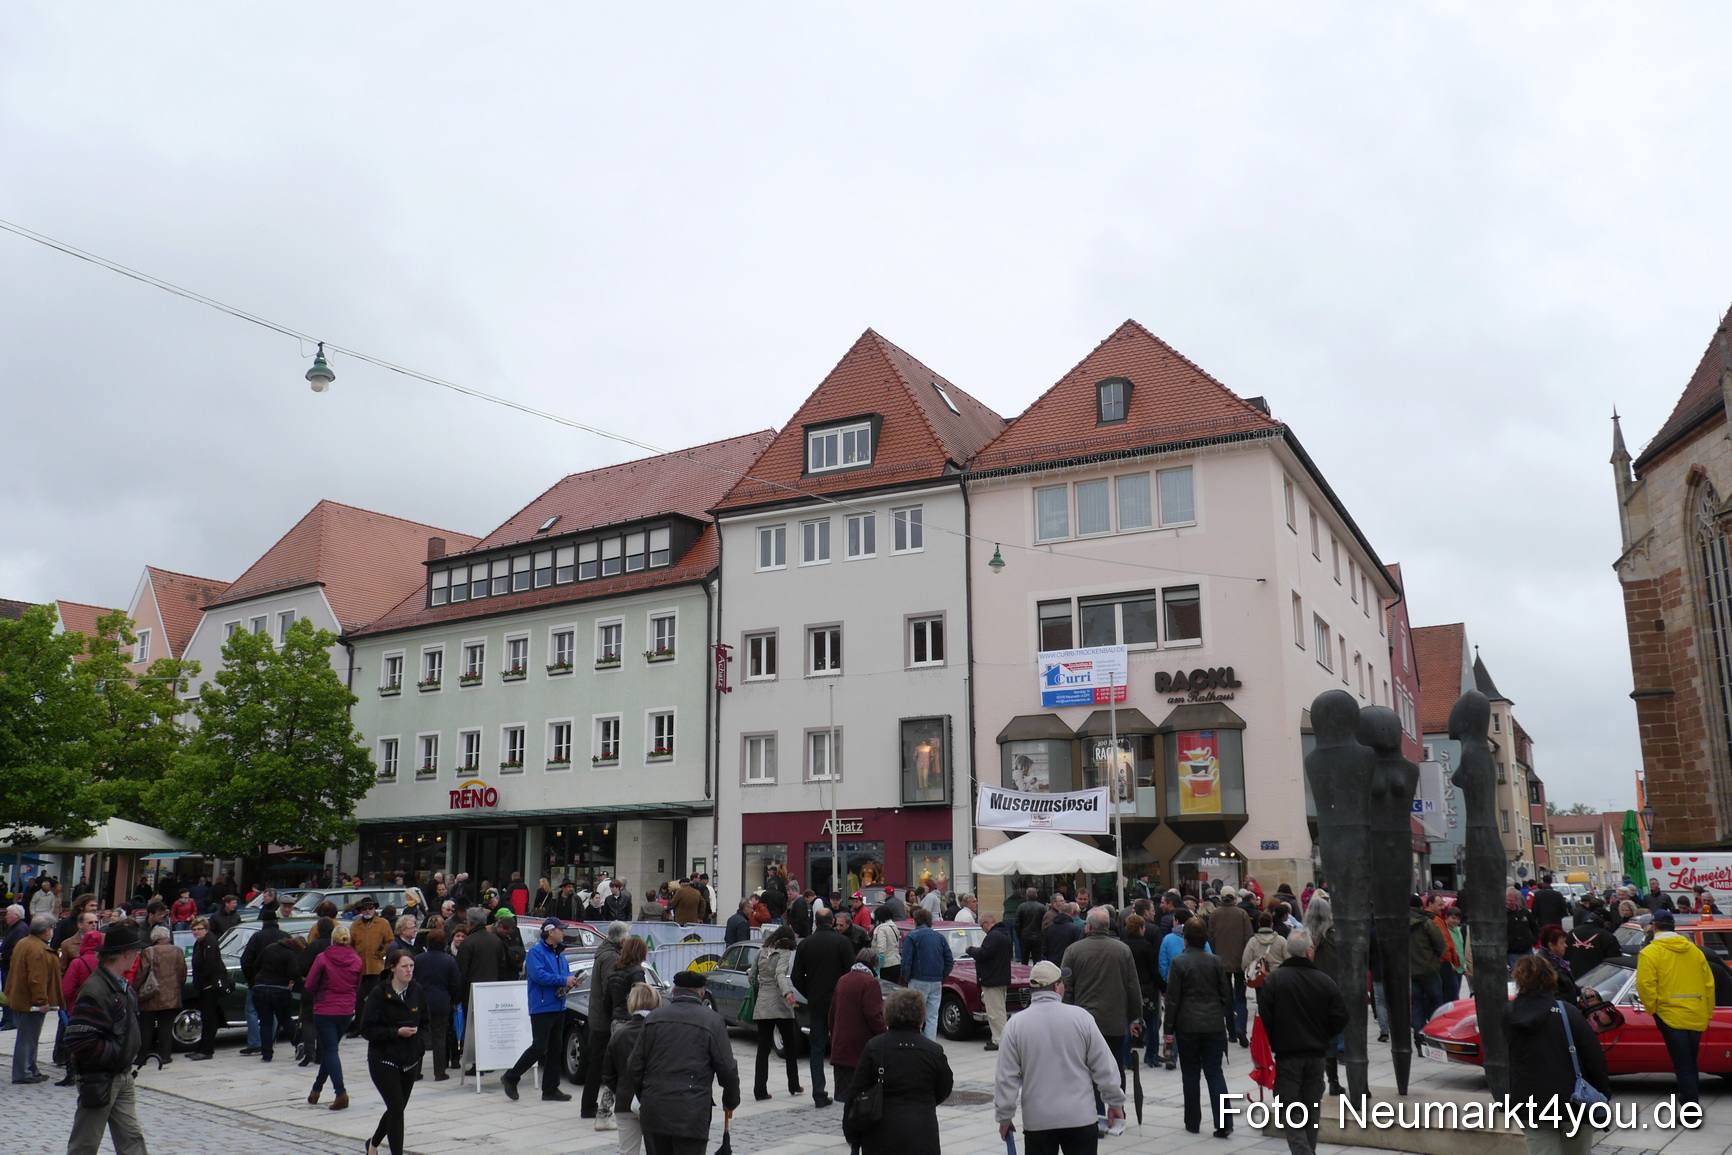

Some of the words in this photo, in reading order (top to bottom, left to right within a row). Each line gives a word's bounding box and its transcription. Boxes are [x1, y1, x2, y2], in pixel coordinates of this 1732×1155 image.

[1040, 646, 1125, 659] WWW.CURRI-TROCKENBAU.DE
[1054, 671, 1091, 685] Curri
[1154, 666, 1242, 693] RACKL
[449, 787, 498, 809] RENO
[990, 793, 1098, 813] Museumsinsel
